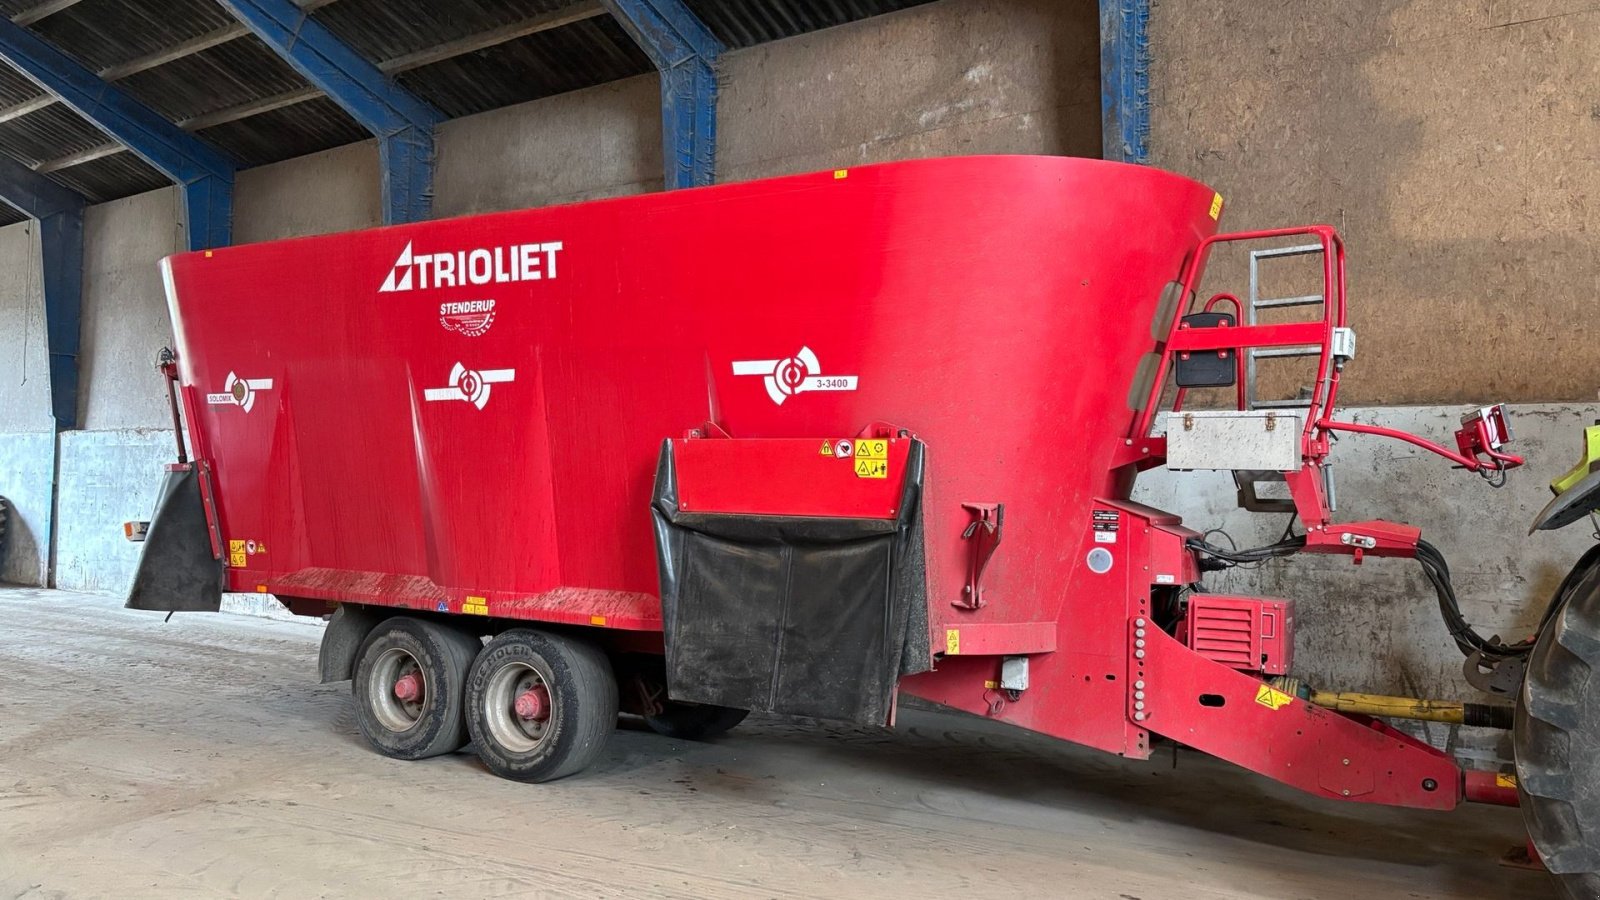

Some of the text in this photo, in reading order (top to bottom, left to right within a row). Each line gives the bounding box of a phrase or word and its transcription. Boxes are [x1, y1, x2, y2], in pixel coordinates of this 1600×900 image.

[413, 241, 563, 289] TRIOLIET
[440, 299, 496, 315] STENDERUP
[816, 379, 849, 388] 3-3400
[209, 394, 232, 403] SOLOMIX
